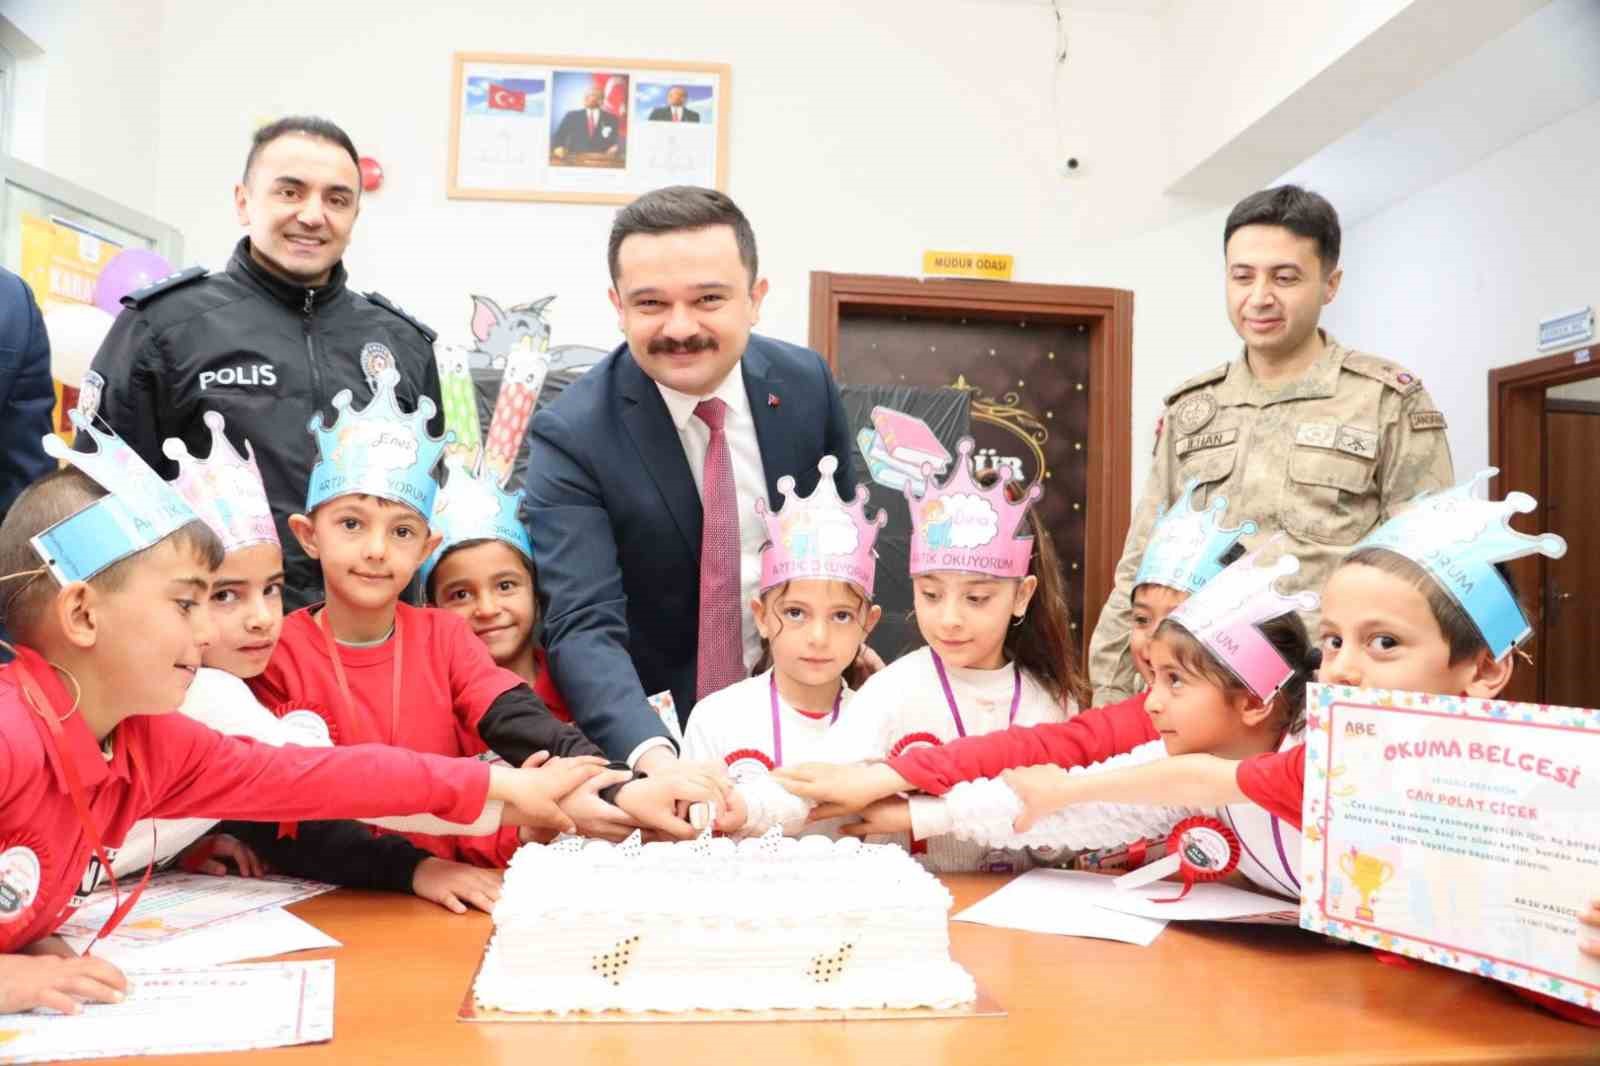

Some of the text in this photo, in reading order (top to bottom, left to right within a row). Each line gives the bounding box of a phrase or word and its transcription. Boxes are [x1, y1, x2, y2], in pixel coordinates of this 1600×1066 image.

[976, 258, 1007, 271] ODASI
[199, 364, 278, 390] POLİS
[968, 447, 1025, 481] ÜR
[942, 553, 1014, 570] OKUYORUM
[1345, 721, 1376, 736] ABE
[1383, 740, 1462, 761] OKUMA
